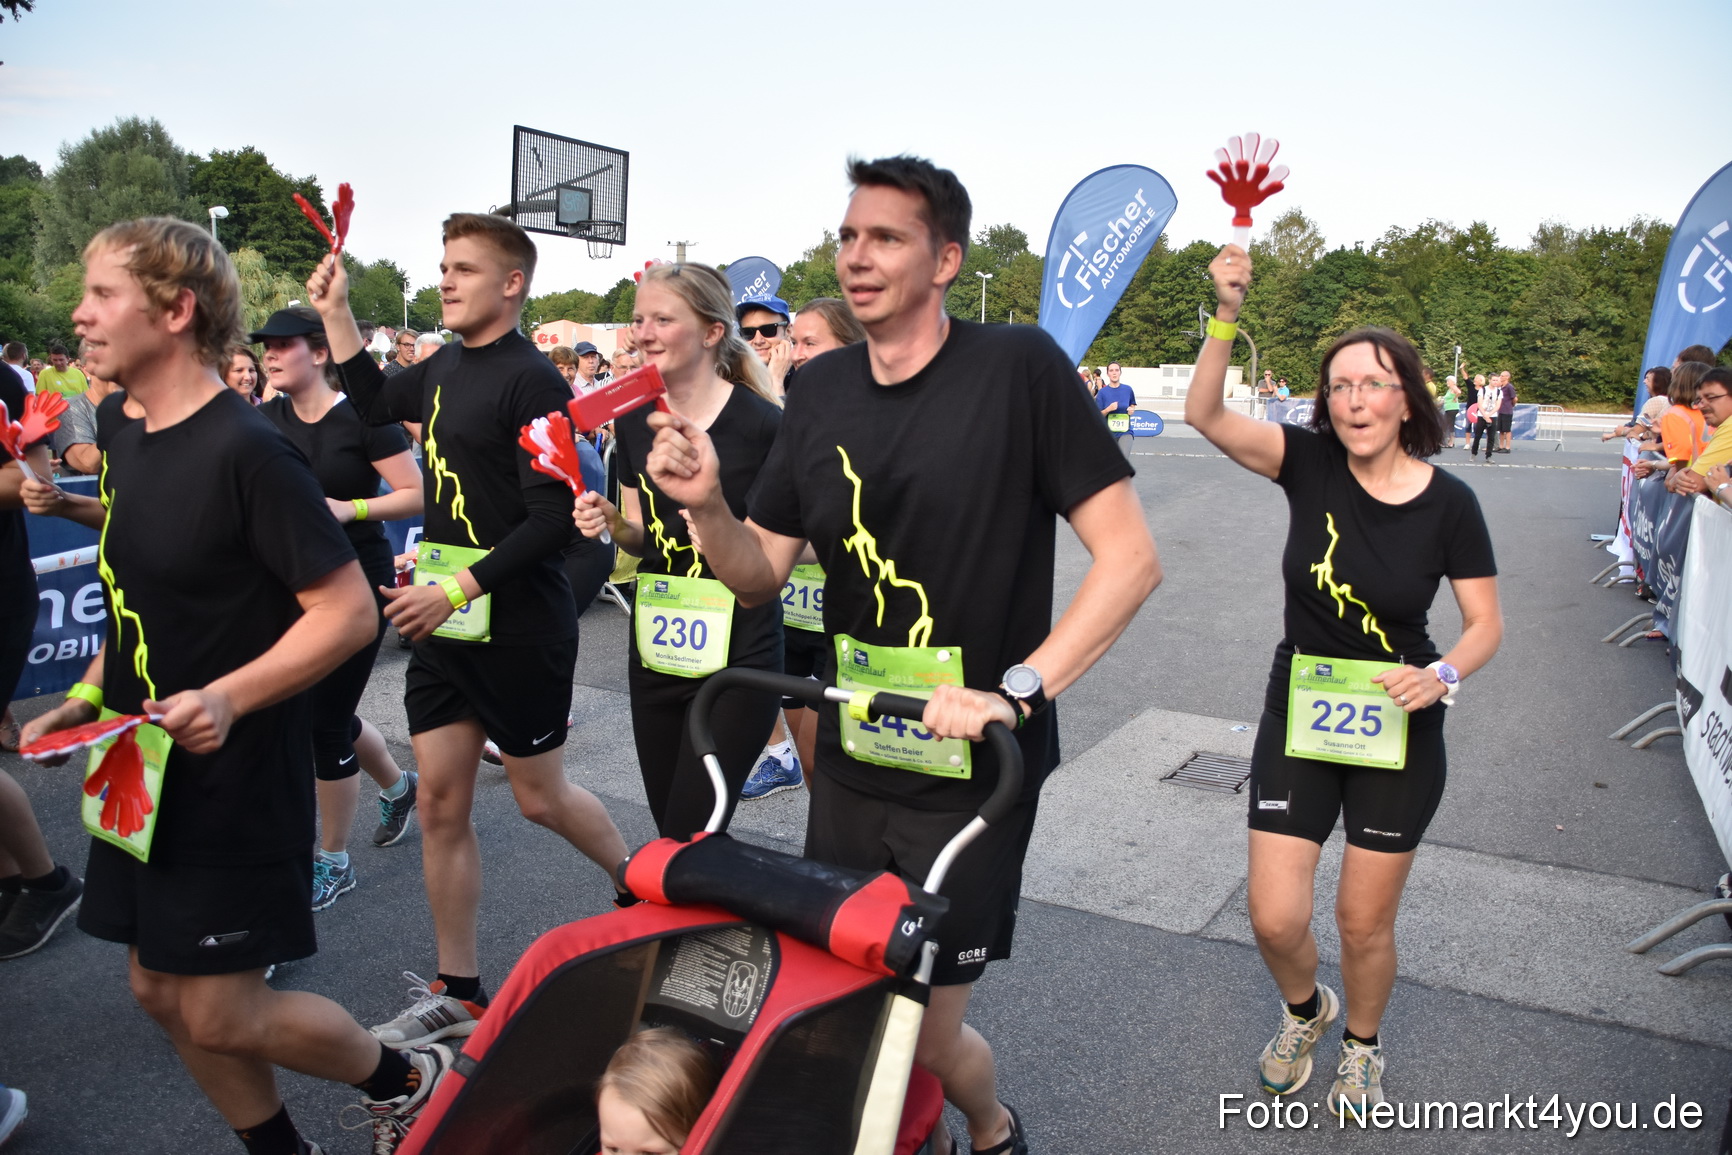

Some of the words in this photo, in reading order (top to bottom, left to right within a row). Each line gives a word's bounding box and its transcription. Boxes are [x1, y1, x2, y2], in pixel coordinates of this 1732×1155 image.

[1074, 188, 1147, 291] Fischer
[1100, 207, 1156, 289] AUTOMOBILE
[736, 270, 767, 304] cher
[537, 333, 559, 345] G6
[652, 615, 708, 651] 230
[655, 652, 674, 660] Monika
[1311, 699, 1382, 737] 225
[874, 741, 901, 753] Steffen
[902, 747, 924, 757] Beier
[1323, 739, 1354, 750] Susanne
[1354, 743, 1366, 751] Ott
[1363, 827, 1402, 837] BROOKS
[958, 947, 987, 960] GORE
